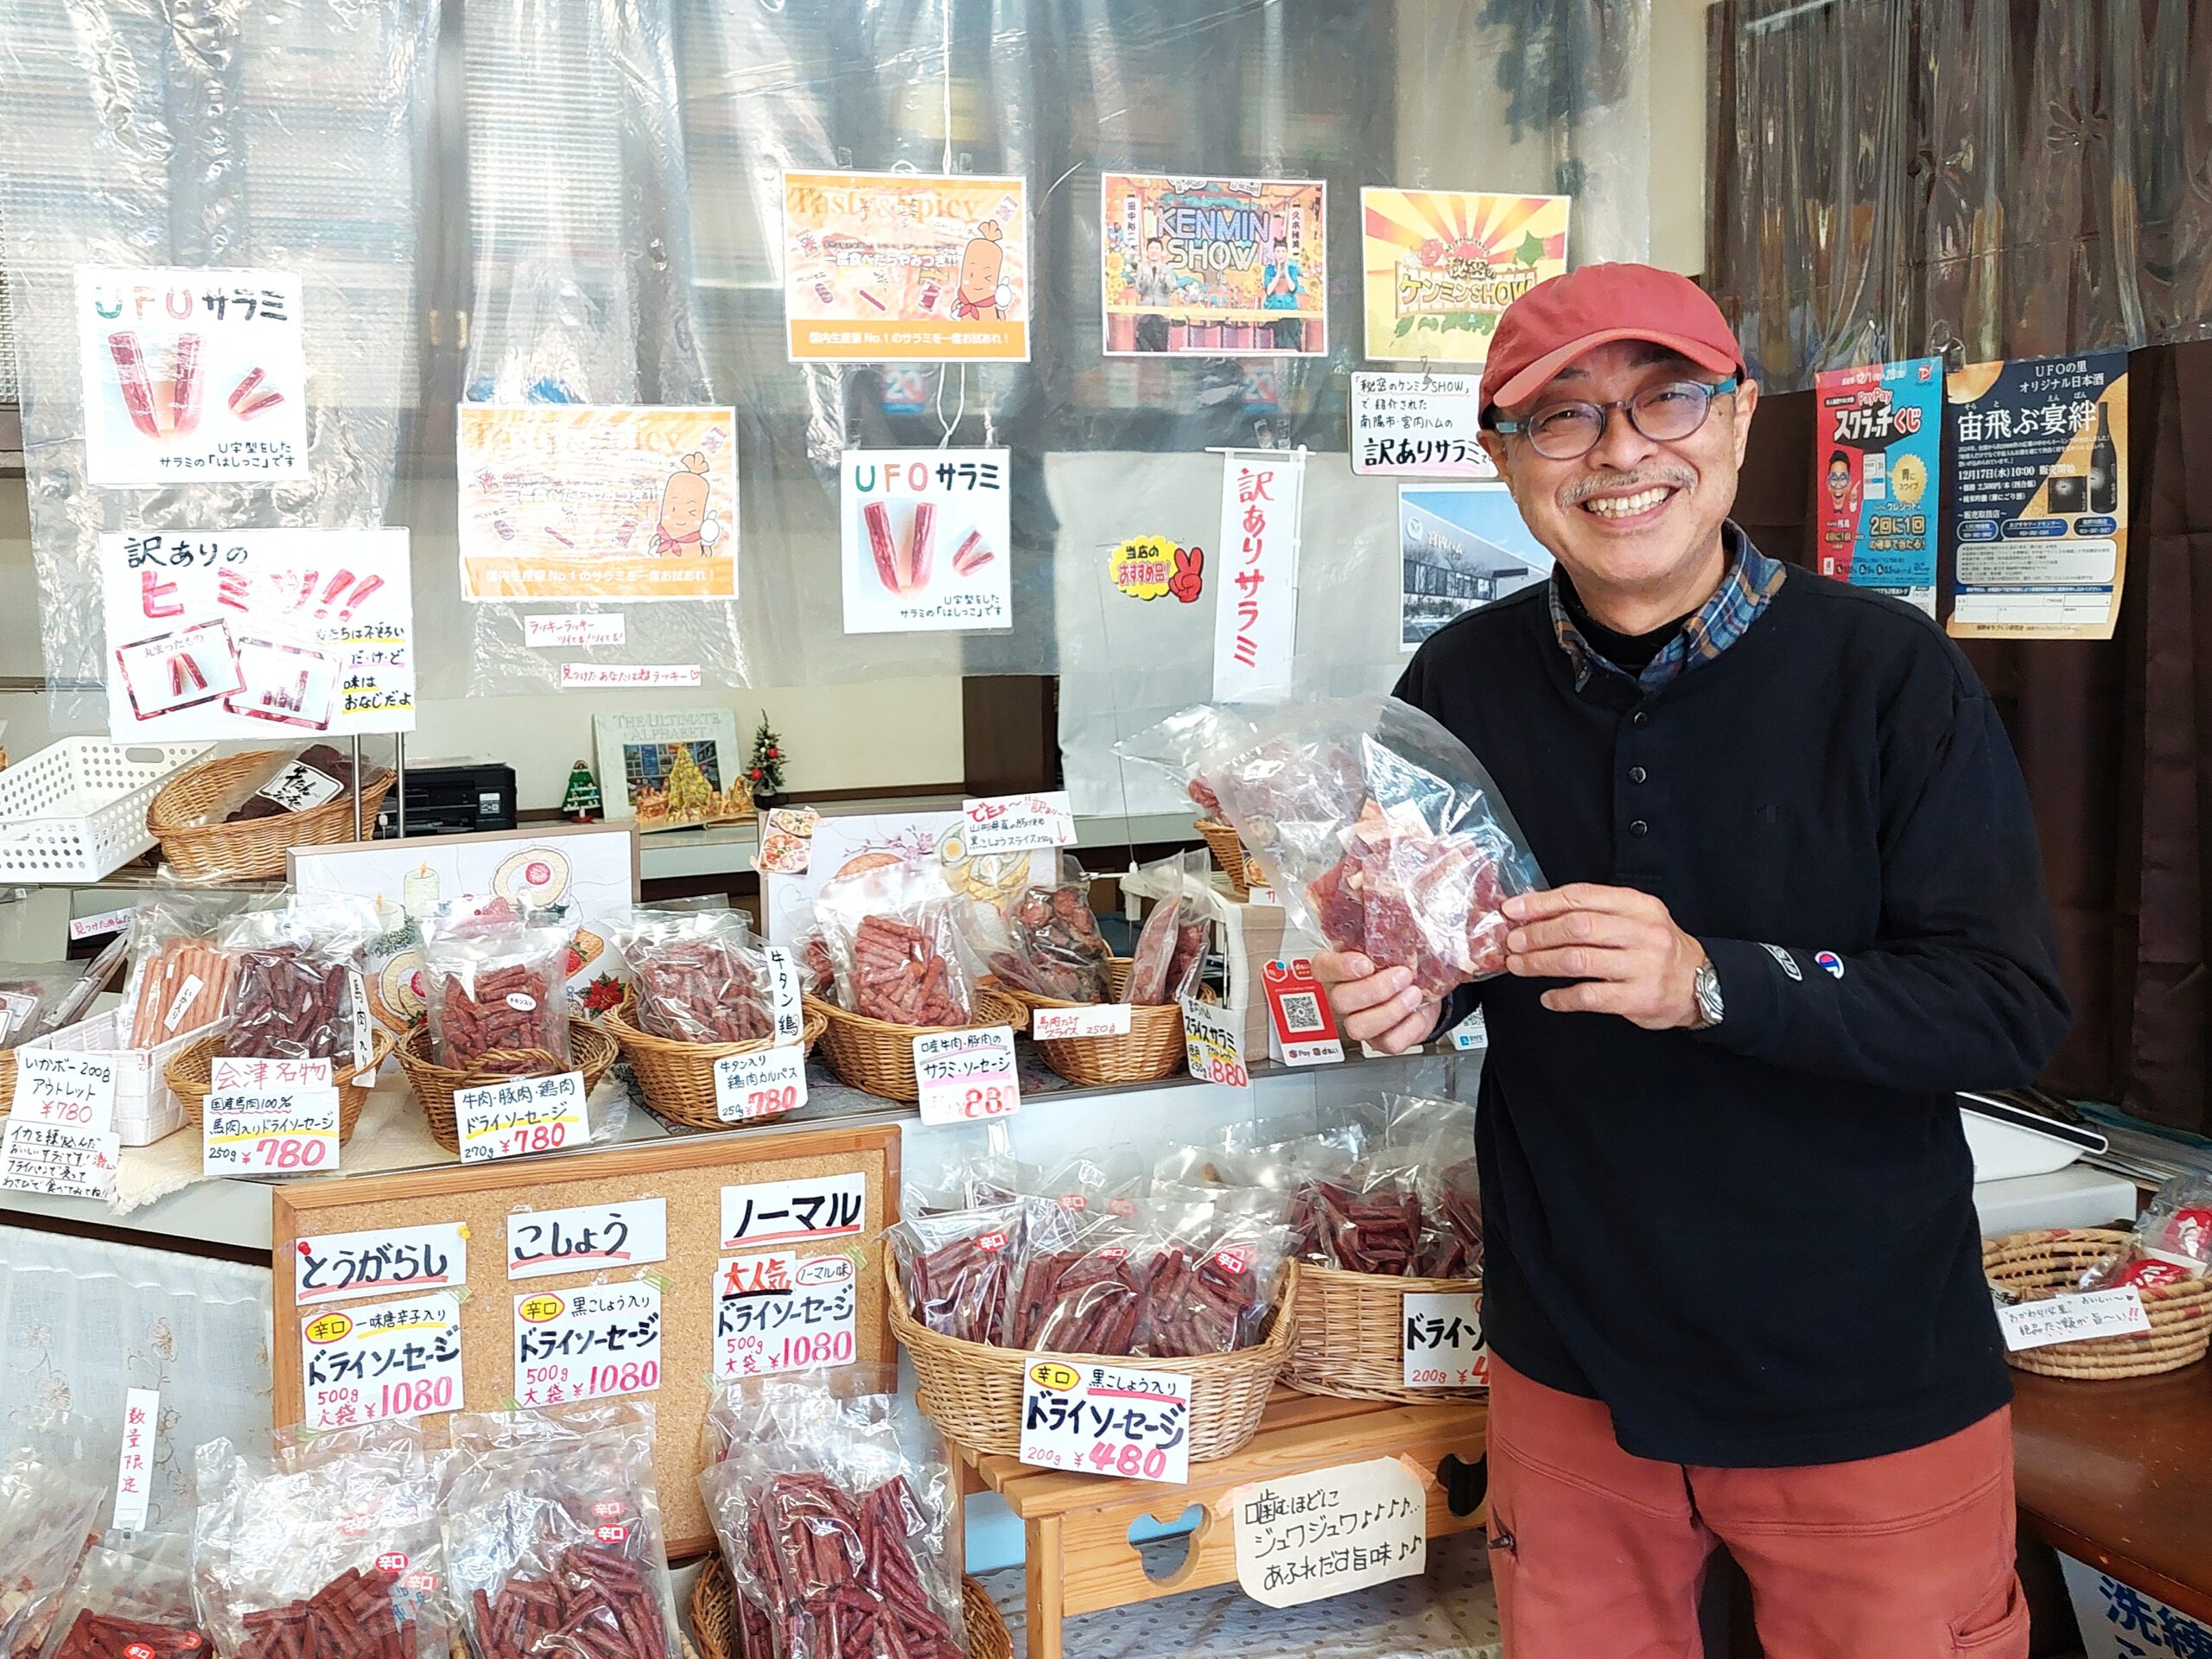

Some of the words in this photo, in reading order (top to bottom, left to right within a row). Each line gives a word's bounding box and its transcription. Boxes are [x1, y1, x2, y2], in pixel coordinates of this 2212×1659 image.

[1158, 207, 1270, 243] KENMIN
[1167, 238, 1258, 271] SHOW
[1399, 274, 1532, 305] ケンミンSHOW
[2019, 372, 2105, 393] オリジナル日本酒
[2035, 360, 2088, 377] UFOの里
[1859, 388, 1892, 405] PayPay
[1834, 404, 1922, 442] スクラッチくじ
[1957, 399, 2098, 442] 宙飛ぶ宴絆
[160, 455, 296, 468] サラミの「はしっこ」です
[219, 442, 291, 454] U字型をした
[855, 462, 1000, 492] UFOサラミ
[1871, 514, 1926, 536] 2回に1回
[124, 537, 248, 568] 訳ありの
[1126, 544, 1160, 559] 当店の
[1234, 467, 1274, 667] 訳ありサラミ
[344, 675, 377, 689] 味は
[345, 692, 413, 711] おなじだよ
[613, 715, 644, 728] THE
[648, 713, 721, 728] ULTIMATE
[630, 727, 707, 741] ALPHABET
[509, 997, 533, 1007] チキン入り
[771, 950, 800, 1036] 牛タン鶏
[215, 1060, 327, 1090] 会津名物
[721, 1055, 766, 1073] 牛タン入り
[728, 1067, 798, 1090] 鶏肉カルパス
[33, 1077, 97, 1102] アウトレット
[211, 1096, 293, 1112] 国産馬肉100%
[462, 1077, 575, 1109] 牛肉・豚肉・鶏肉
[41, 1100, 93, 1123] ¥780
[209, 1111, 334, 1135] 馬肉入りドライソーセージ
[466, 1101, 568, 1134] ドライソーセージ
[208, 1147, 237, 1161] 250g
[242, 1138, 327, 1168] ¥780
[465, 1146, 494, 1159] 270g
[499, 1122, 566, 1154] ¥780
[734, 1192, 861, 1238] ノーマル
[514, 1213, 628, 1261] こしょう
[980, 1234, 1006, 1252] 辛口
[302, 1243, 448, 1289] とうがらし
[723, 1258, 791, 1294] 大人気
[800, 1262, 852, 1281] ノーマル味
[1217, 1252, 1243, 1274] 辛口
[526, 1300, 557, 1319] 辛口
[571, 1295, 651, 1318] 黒こしょう入り
[718, 1283, 853, 1338] ドライソーセージ
[315, 1320, 345, 1339] 辛口
[355, 1310, 446, 1329] 一味唐辛子入り
[520, 1312, 659, 1363] ドライソーセージ
[308, 1325, 461, 1387] ドライソーセージ
[725, 1354, 760, 1376] 大袋
[768, 1331, 852, 1368] ¥1080
[727, 1335, 763, 1355] 500g
[524, 1383, 565, 1406] 大袋
[574, 1360, 658, 1397] ¥1080
[527, 1365, 569, 1384] 500g
[1038, 1365, 1070, 1384] 辛口
[1089, 1369, 1177, 1395] 黒こしょう入り
[1412, 1370, 1447, 1383] 200g
[318, 1388, 359, 1406] 500g
[318, 1403, 358, 1427] 大袋
[365, 1376, 453, 1419] ¥1080
[1027, 1389, 1186, 1450] ドライソーセージ
[121, 1406, 146, 1493] 数量限定
[1027, 1446, 1061, 1466] 200g
[1074, 1441, 1166, 1478] ¥480
[1245, 1489, 1339, 1524] 噛むほどに
[598, 1526, 624, 1541] 辛口
[378, 1554, 405, 1570] 辛口
[128, 1646, 151, 1659] 辛口
